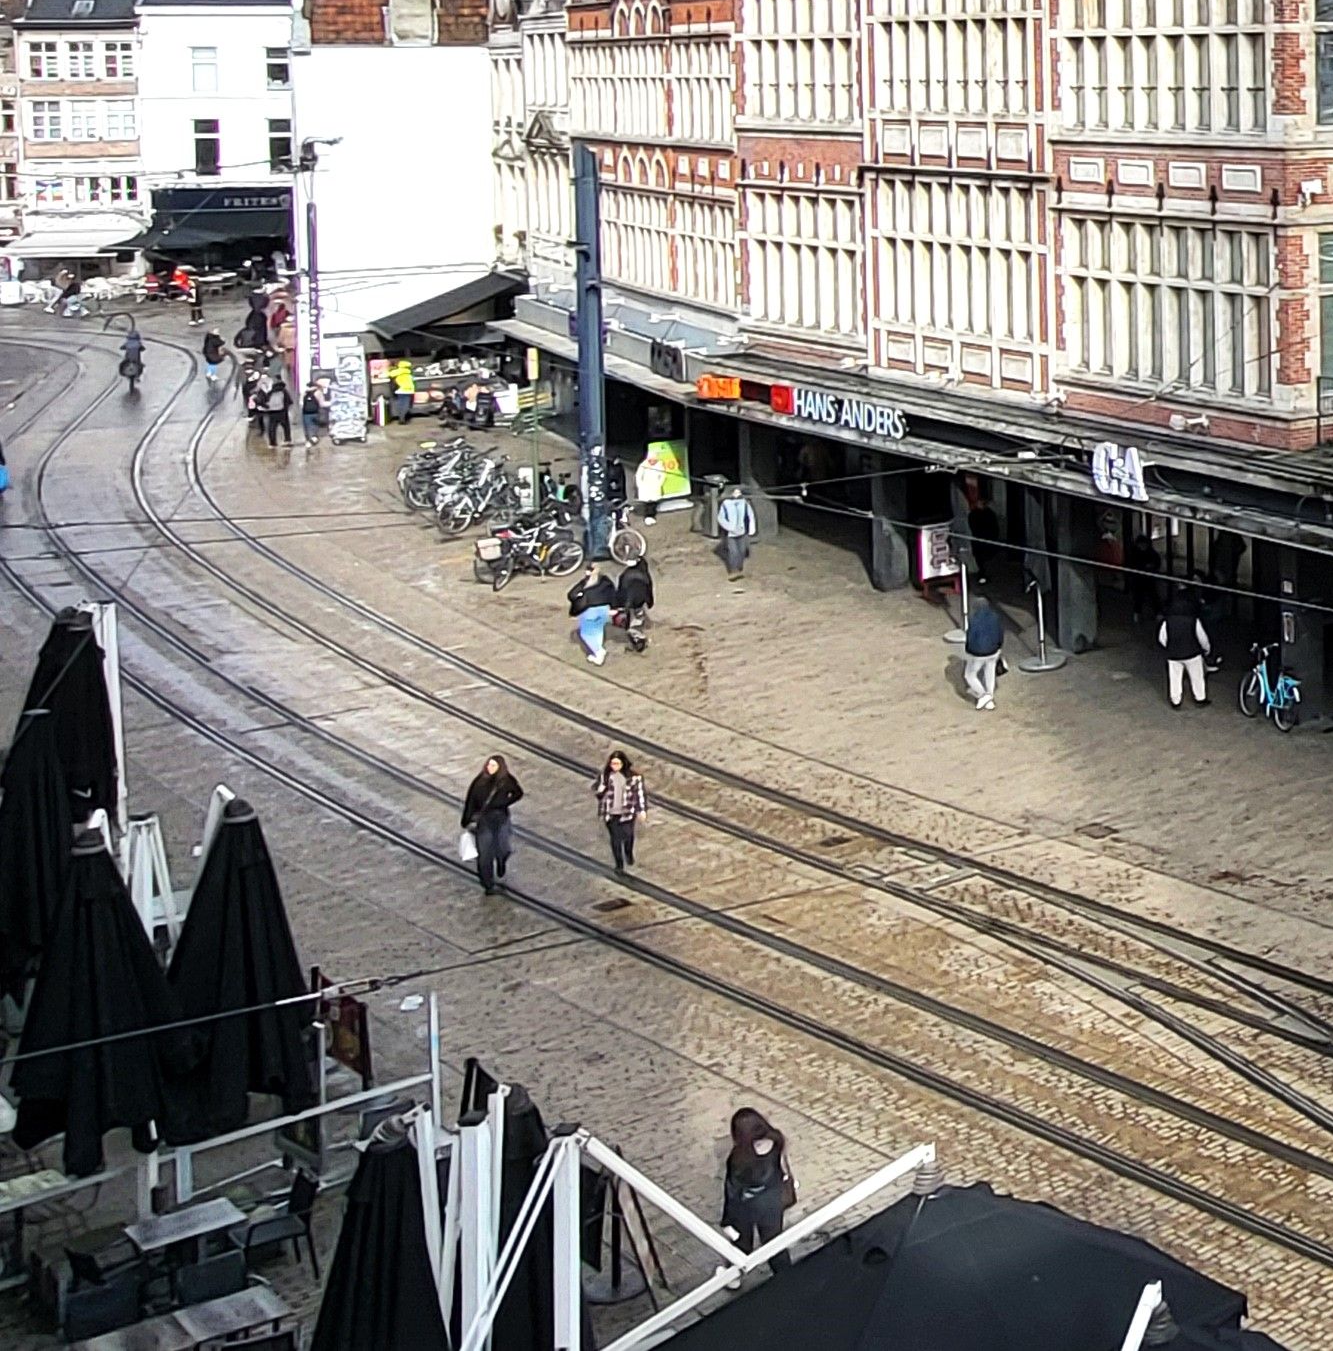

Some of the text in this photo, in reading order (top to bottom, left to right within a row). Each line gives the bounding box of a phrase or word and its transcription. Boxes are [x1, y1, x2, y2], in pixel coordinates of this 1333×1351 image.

[223, 197, 279, 207] FRITES
[793, 387, 905, 440] HANS ANDERS
[1092, 441, 1149, 501] C&A
